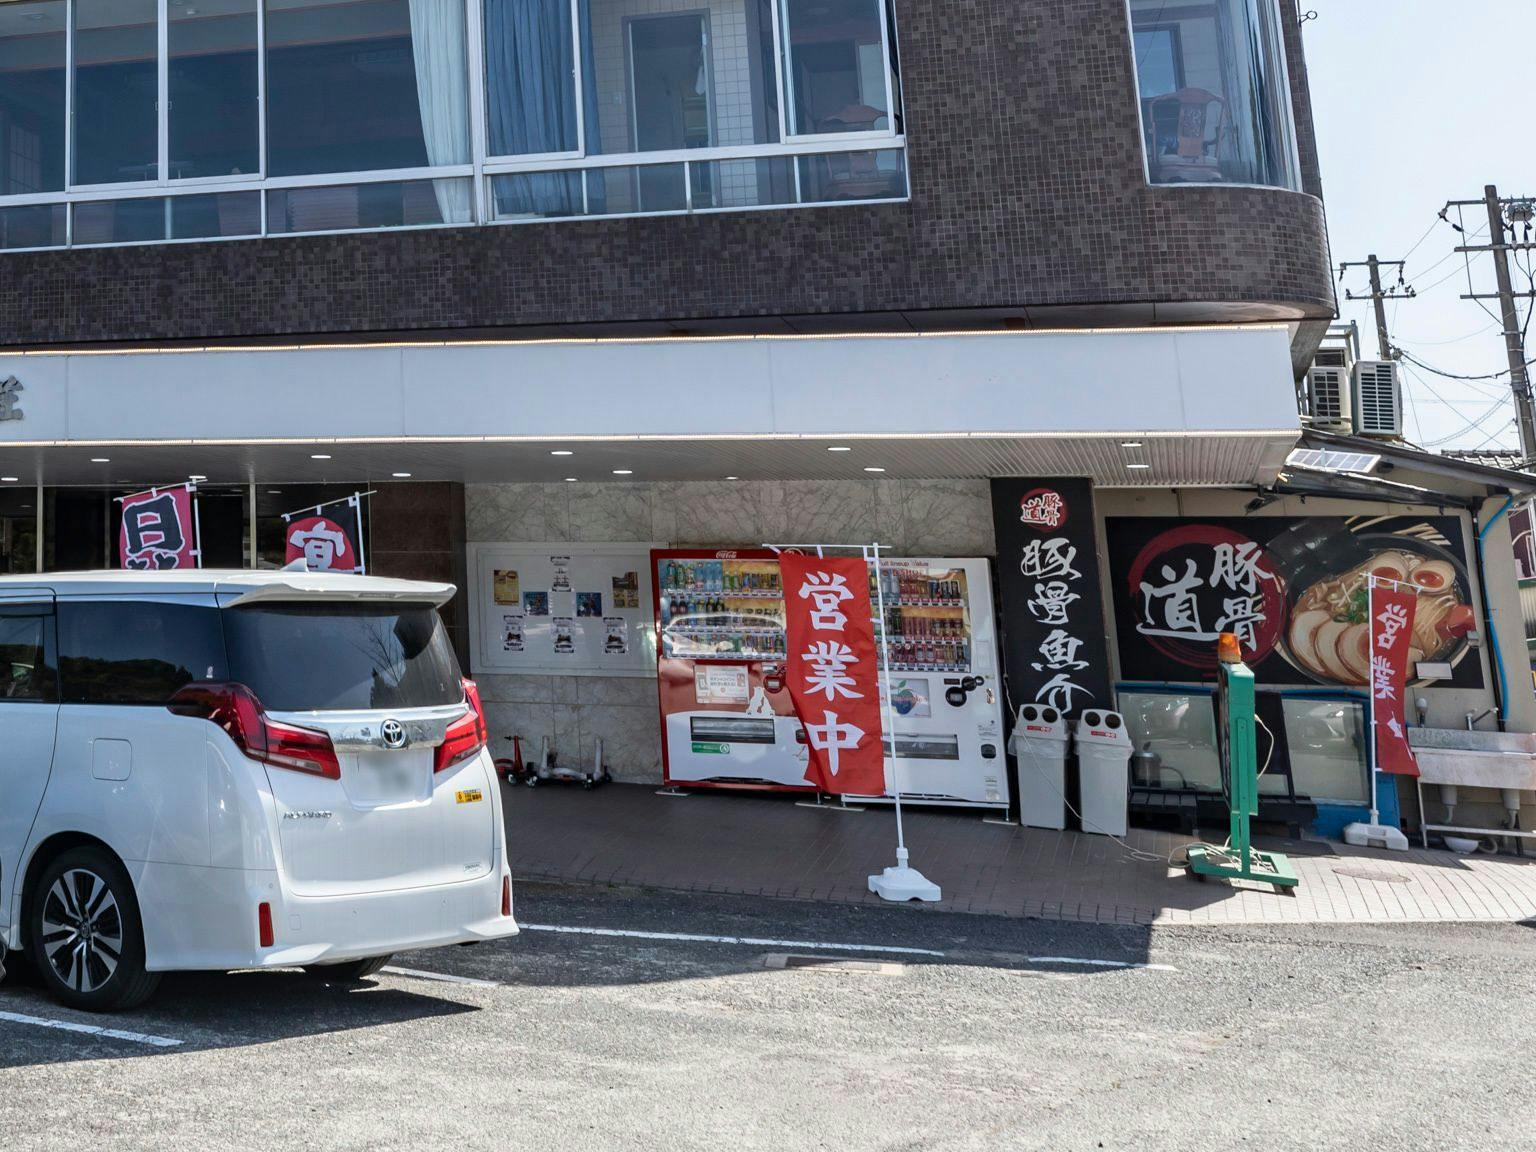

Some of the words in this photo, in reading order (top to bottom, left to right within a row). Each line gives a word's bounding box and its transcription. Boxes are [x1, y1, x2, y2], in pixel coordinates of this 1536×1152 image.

[1020, 537, 1096, 715] 豚骨魚介
[1136, 558, 1221, 642] 道
[1208, 540, 1274, 653] 豚骨
[797, 571, 866, 777] 営業中
